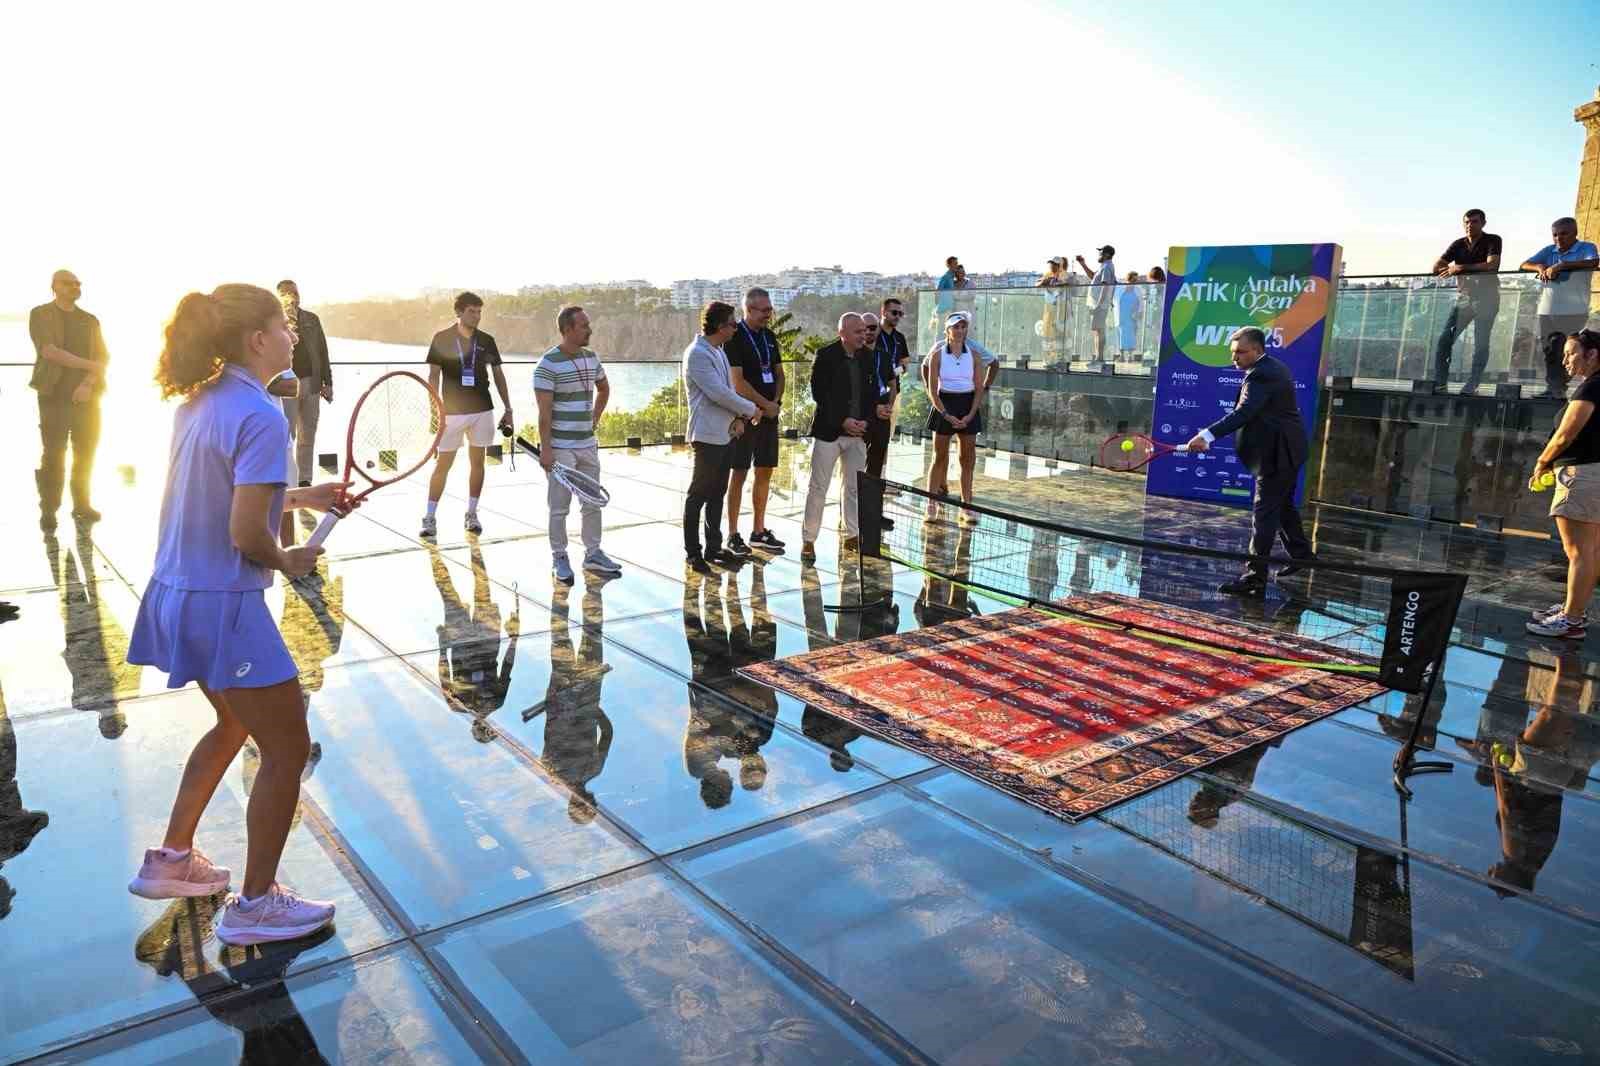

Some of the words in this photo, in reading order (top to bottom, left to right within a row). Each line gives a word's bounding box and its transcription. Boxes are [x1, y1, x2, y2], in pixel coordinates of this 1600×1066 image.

[1241, 274, 1316, 298] Antalya
[1239, 293, 1294, 316] Open
[1400, 591, 1420, 656] ARTENGO
